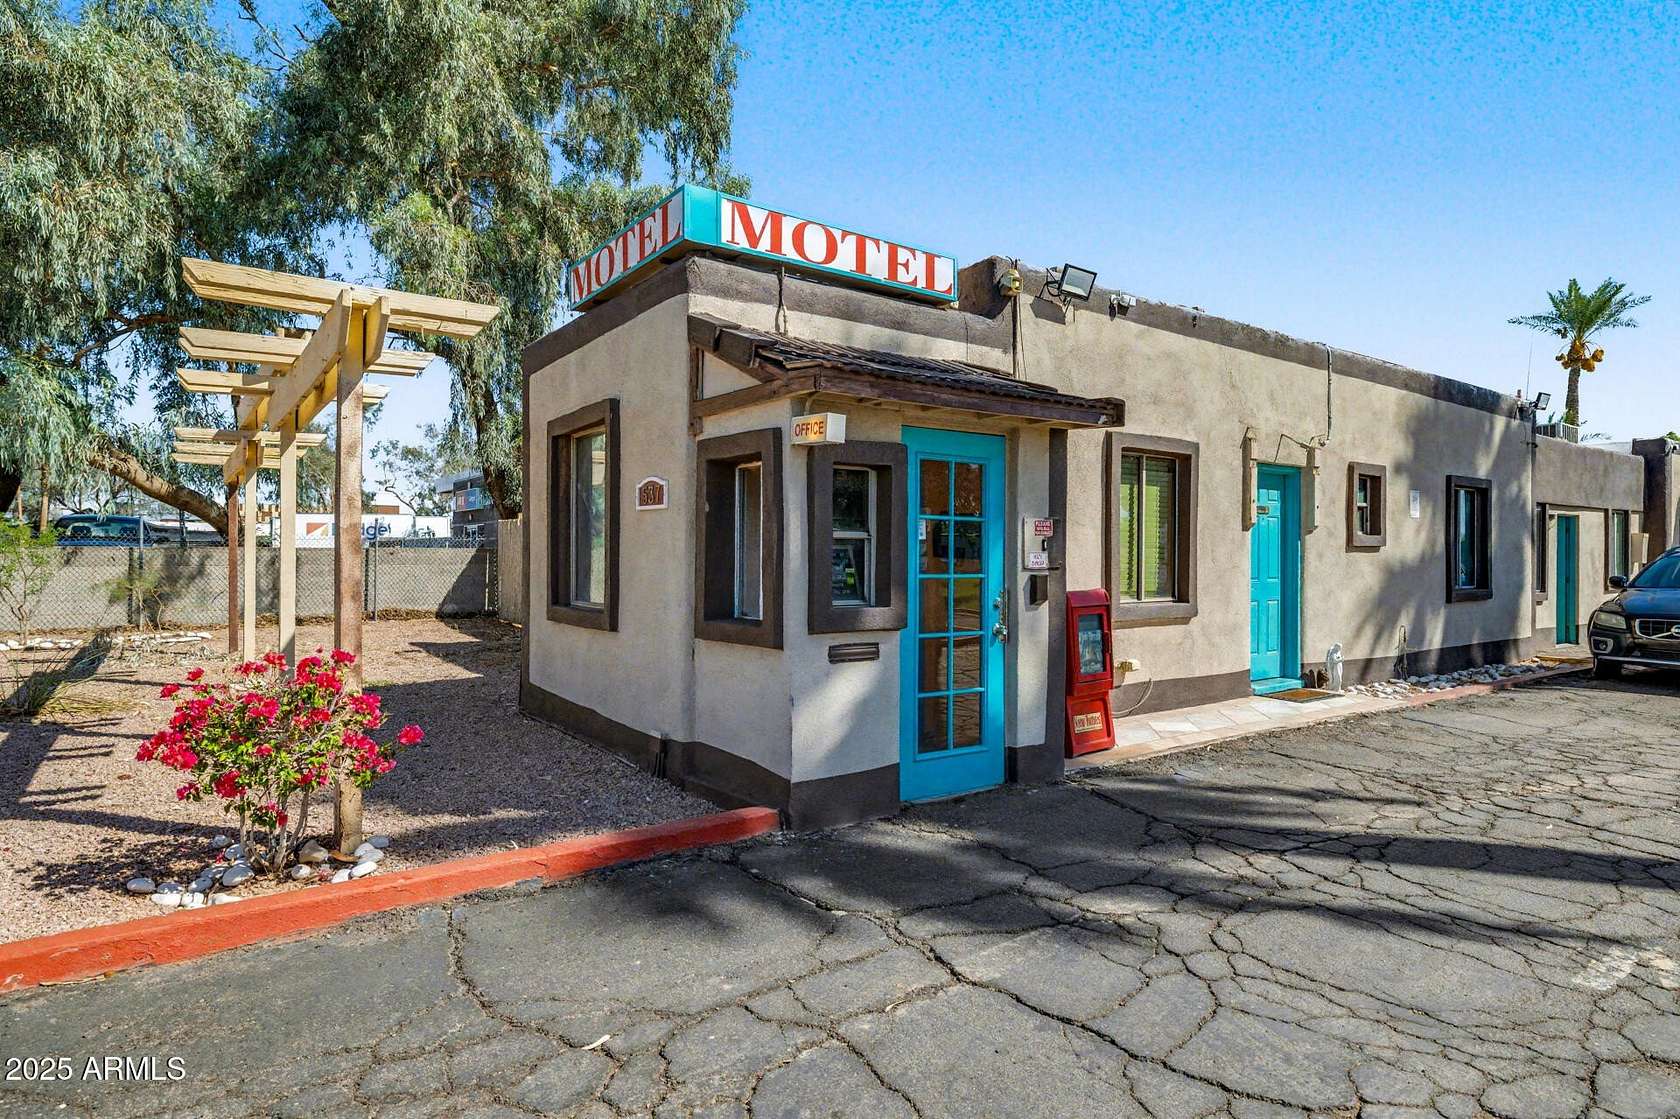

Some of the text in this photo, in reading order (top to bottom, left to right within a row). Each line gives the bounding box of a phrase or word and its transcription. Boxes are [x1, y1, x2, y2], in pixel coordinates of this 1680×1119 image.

[572, 199, 681, 303] MOTEL
[726, 200, 953, 295] MOTEL
[794, 421, 824, 437] OFFICE
